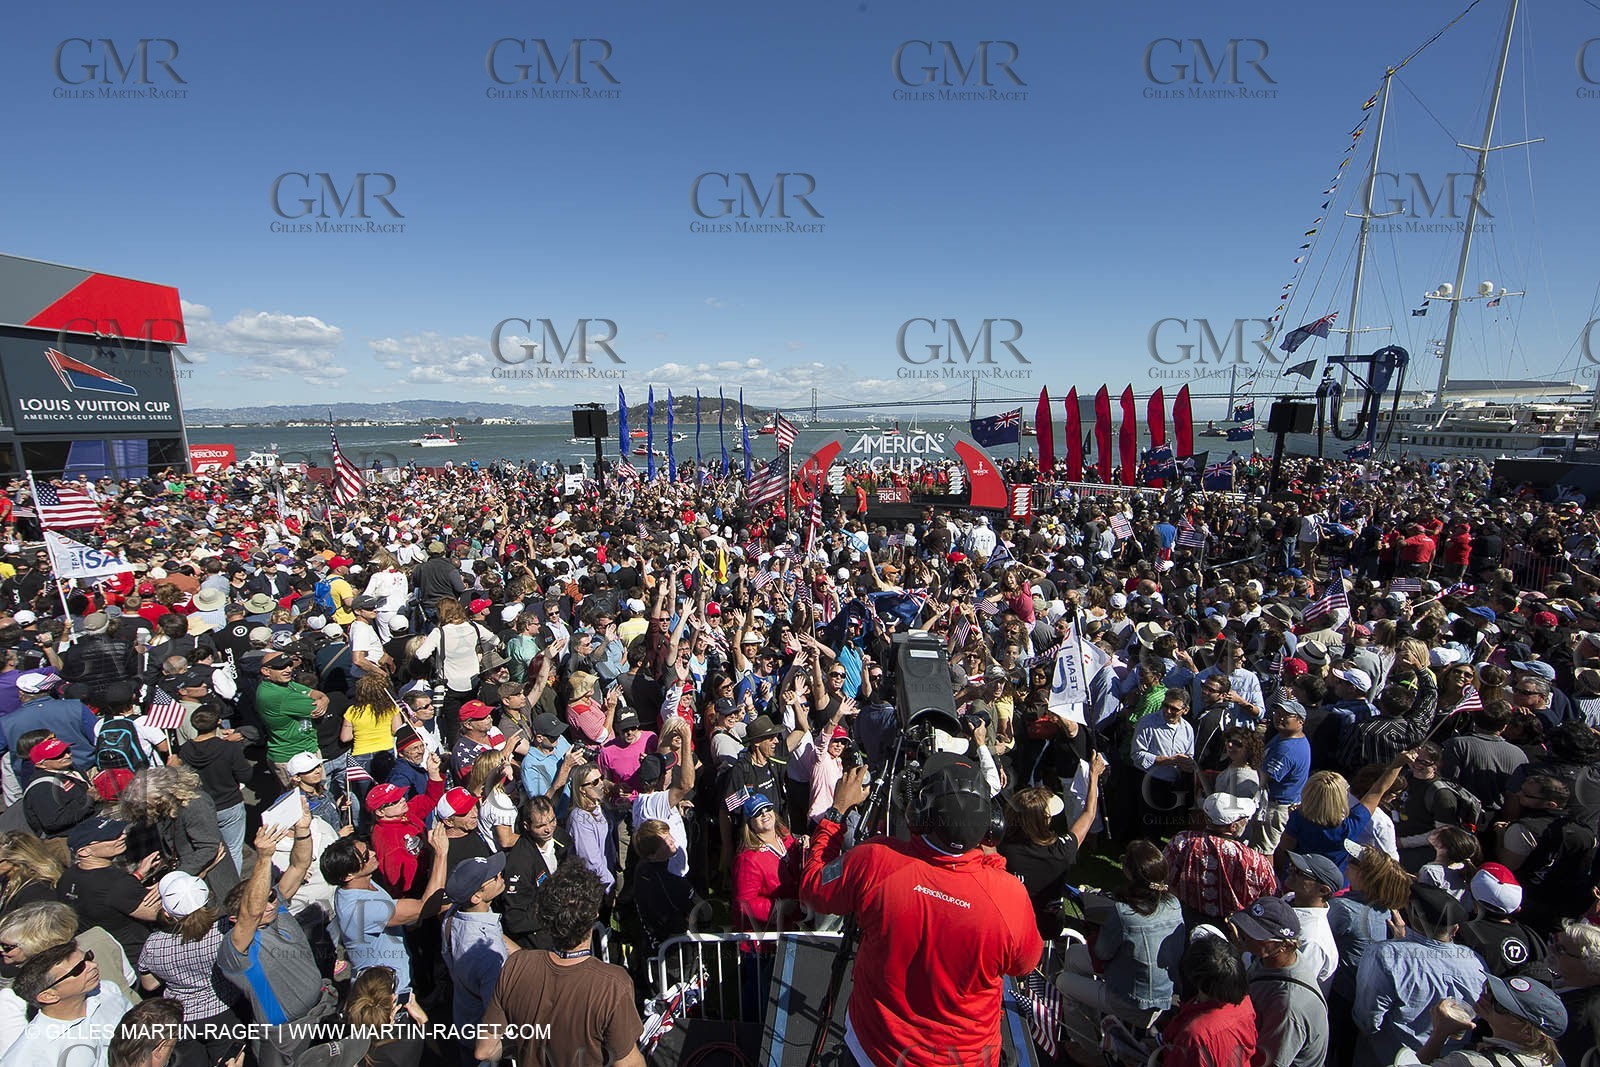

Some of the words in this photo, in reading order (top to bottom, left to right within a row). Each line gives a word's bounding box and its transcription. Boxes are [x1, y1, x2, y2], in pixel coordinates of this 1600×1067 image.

[19, 399, 71, 411] LOUIS
[75, 400, 140, 412] VUITTON
[145, 402, 170, 412] CUP
[849, 433, 946, 454] AMERICA'S
[869, 456, 923, 475] CUP
[79, 549, 124, 570] SA
[1508, 945, 1521, 958] 17
